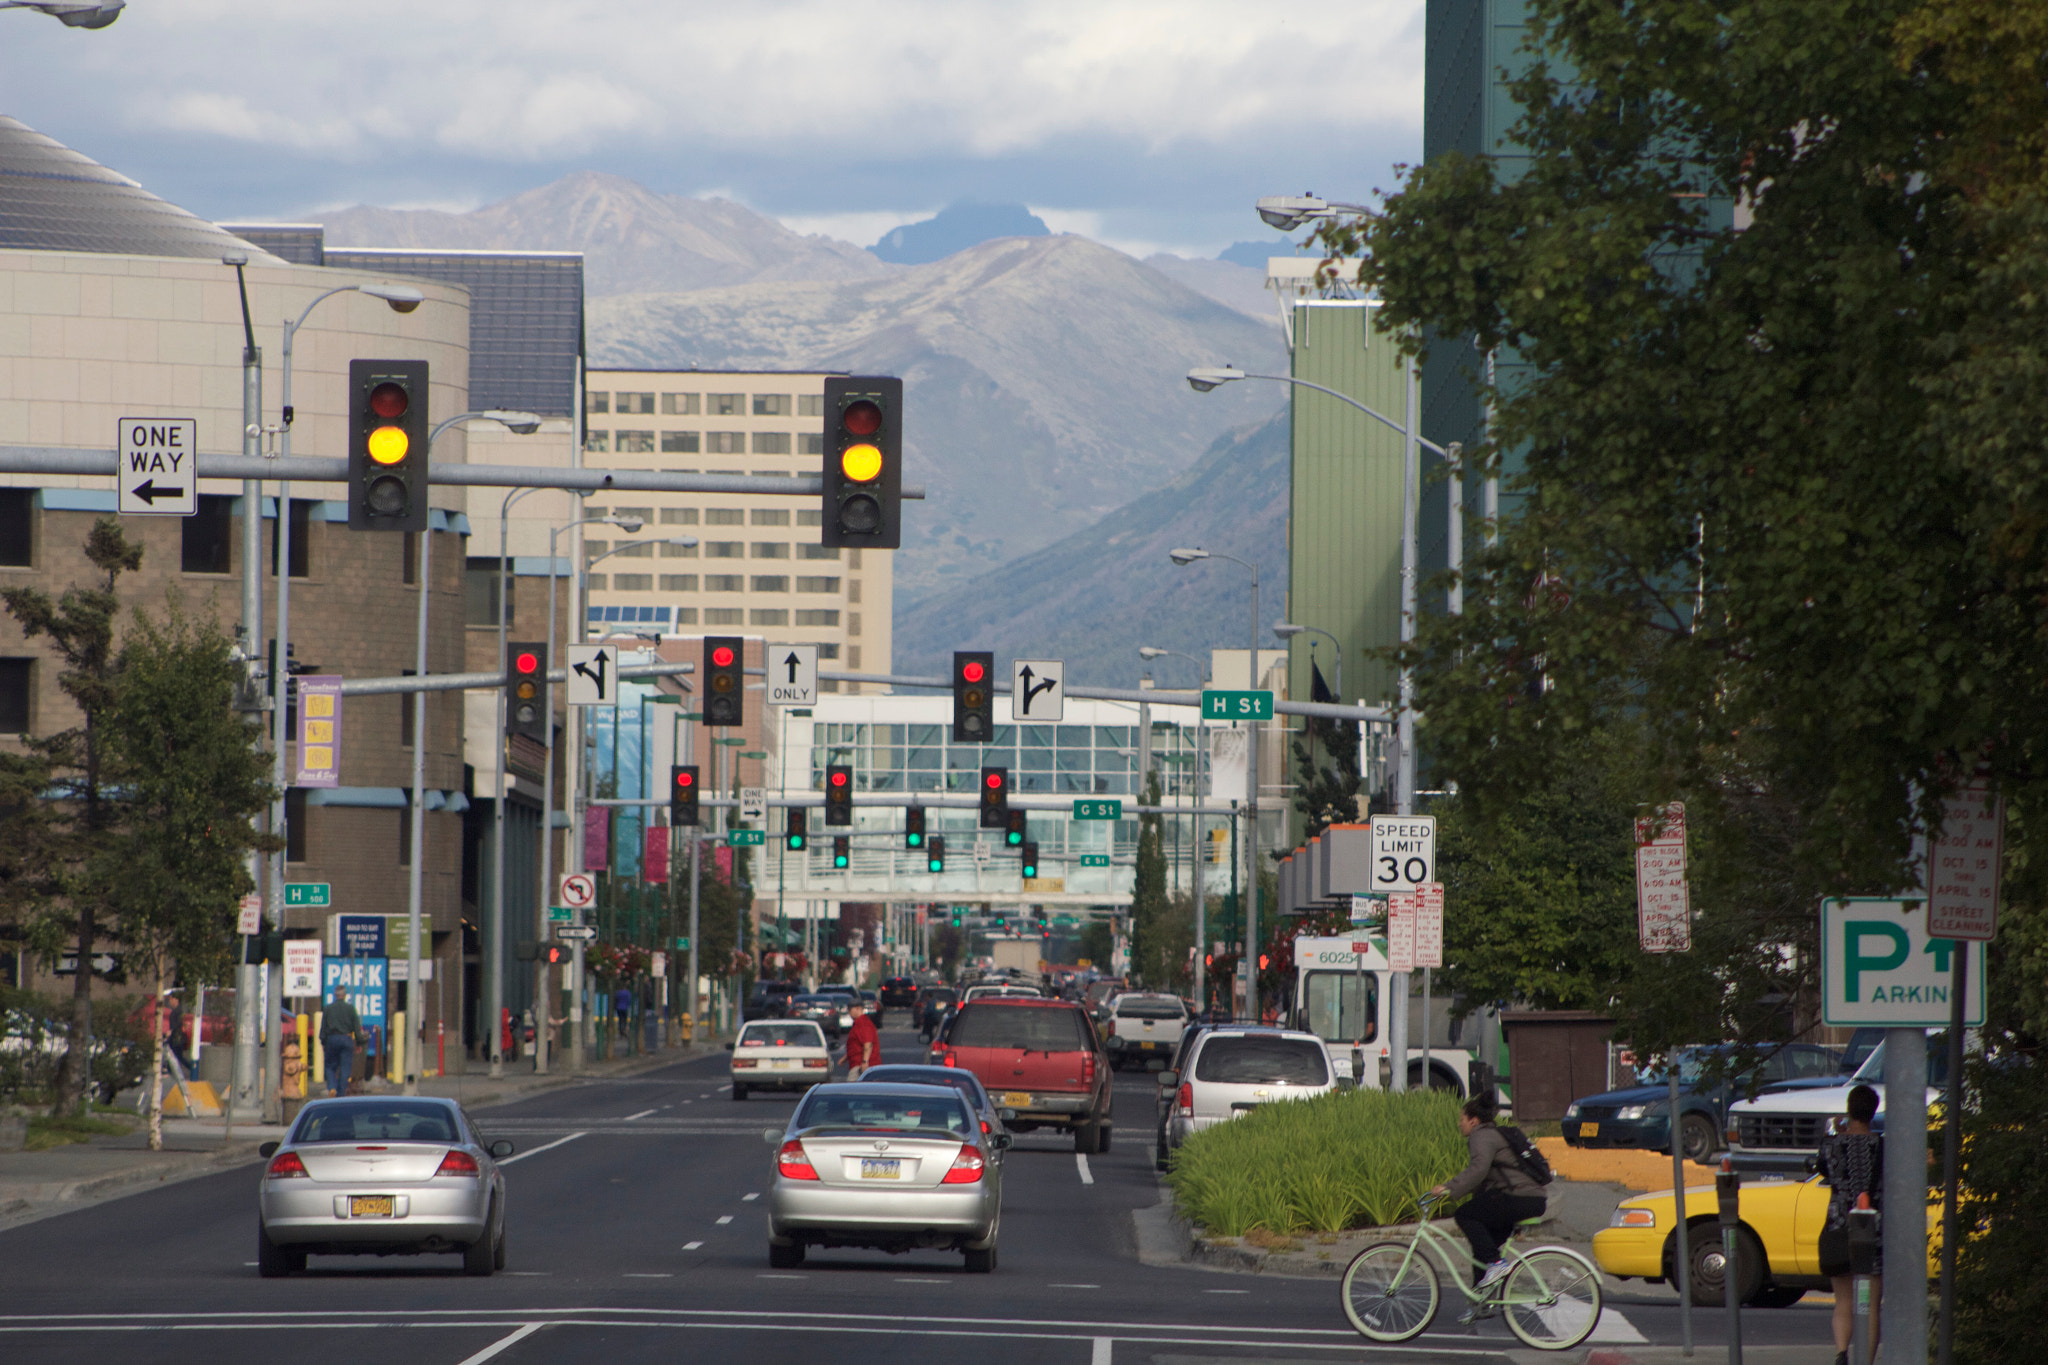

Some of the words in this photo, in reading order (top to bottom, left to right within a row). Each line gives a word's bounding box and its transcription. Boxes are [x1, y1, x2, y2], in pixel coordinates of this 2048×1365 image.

[133, 426, 182, 447] ONE
[130, 452, 184, 473] WAY
[774, 688, 809, 700] ONLY
[1213, 697, 1227, 713] H
[1239, 697, 1261, 713] St
[744, 789, 762, 798] ONE
[1081, 804, 1090, 816] G
[1098, 804, 1114, 816] St
[1376, 824, 1431, 838] SPEED
[734, 832, 742, 842] F
[748, 832, 760, 843] St
[1975, 838, 1994, 849] AM
[1381, 840, 1424, 853] LIMIT
[1643, 860, 1663, 868] 2:00
[1668, 859, 1681, 867] AM
[1975, 859, 1988, 870] 15
[1377, 856, 1427, 884] 30
[1954, 872, 1976, 882] THRU
[1644, 879, 1664, 888] 6:00
[1669, 879, 1681, 887] AM
[292, 888, 302, 901] H
[1671, 893, 1680, 902] 15
[1936, 885, 1972, 897] APRIL
[1979, 887, 1991, 898] 15
[1355, 900, 1367, 908] BUS
[1353, 908, 1368, 916] STOP
[1940, 906, 1984, 918] STREET
[242, 921, 255, 929] TIME
[1932, 918, 1991, 932] CLEANING
[327, 964, 383, 987] PARK
